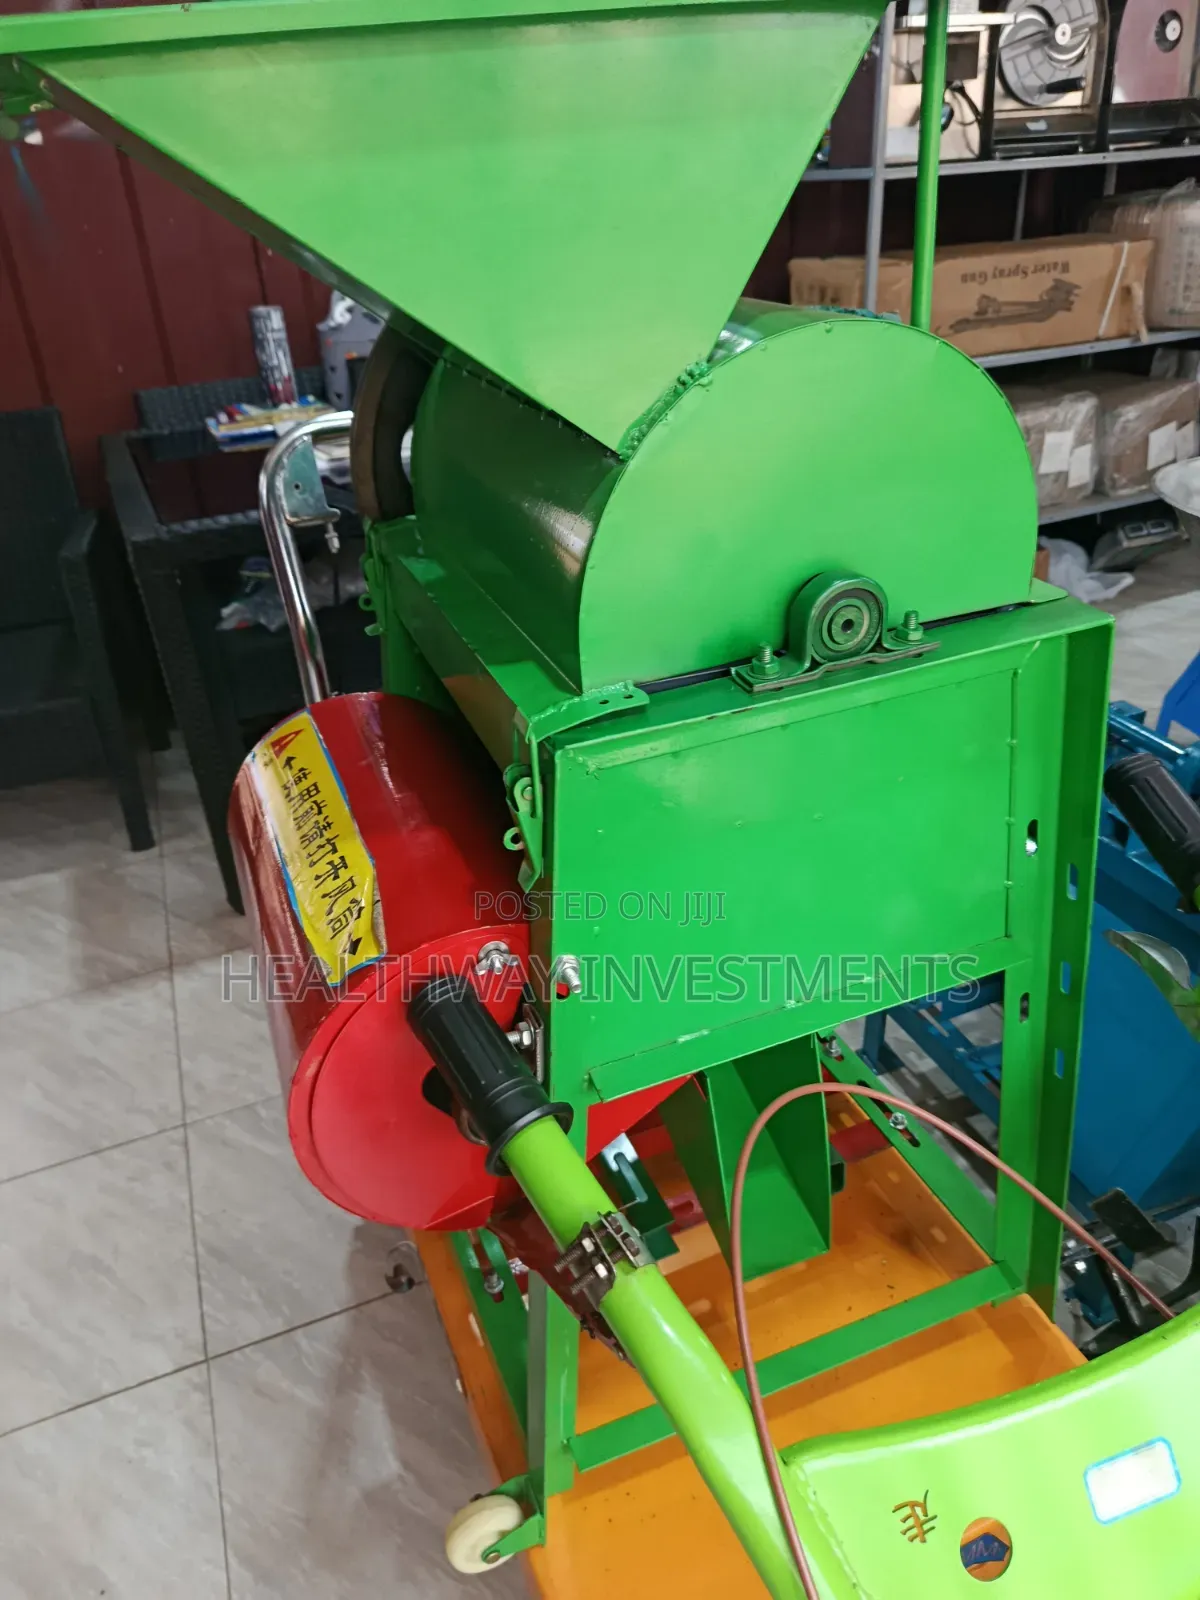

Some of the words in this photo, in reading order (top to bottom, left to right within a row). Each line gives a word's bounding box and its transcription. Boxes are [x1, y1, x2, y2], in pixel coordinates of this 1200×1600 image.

[991, 264, 1029, 279] Spray
[1030, 260, 1070, 275] Water
[960, 270, 988, 285] Gun
[281, 766, 367, 940] 使用前请打开风筒
